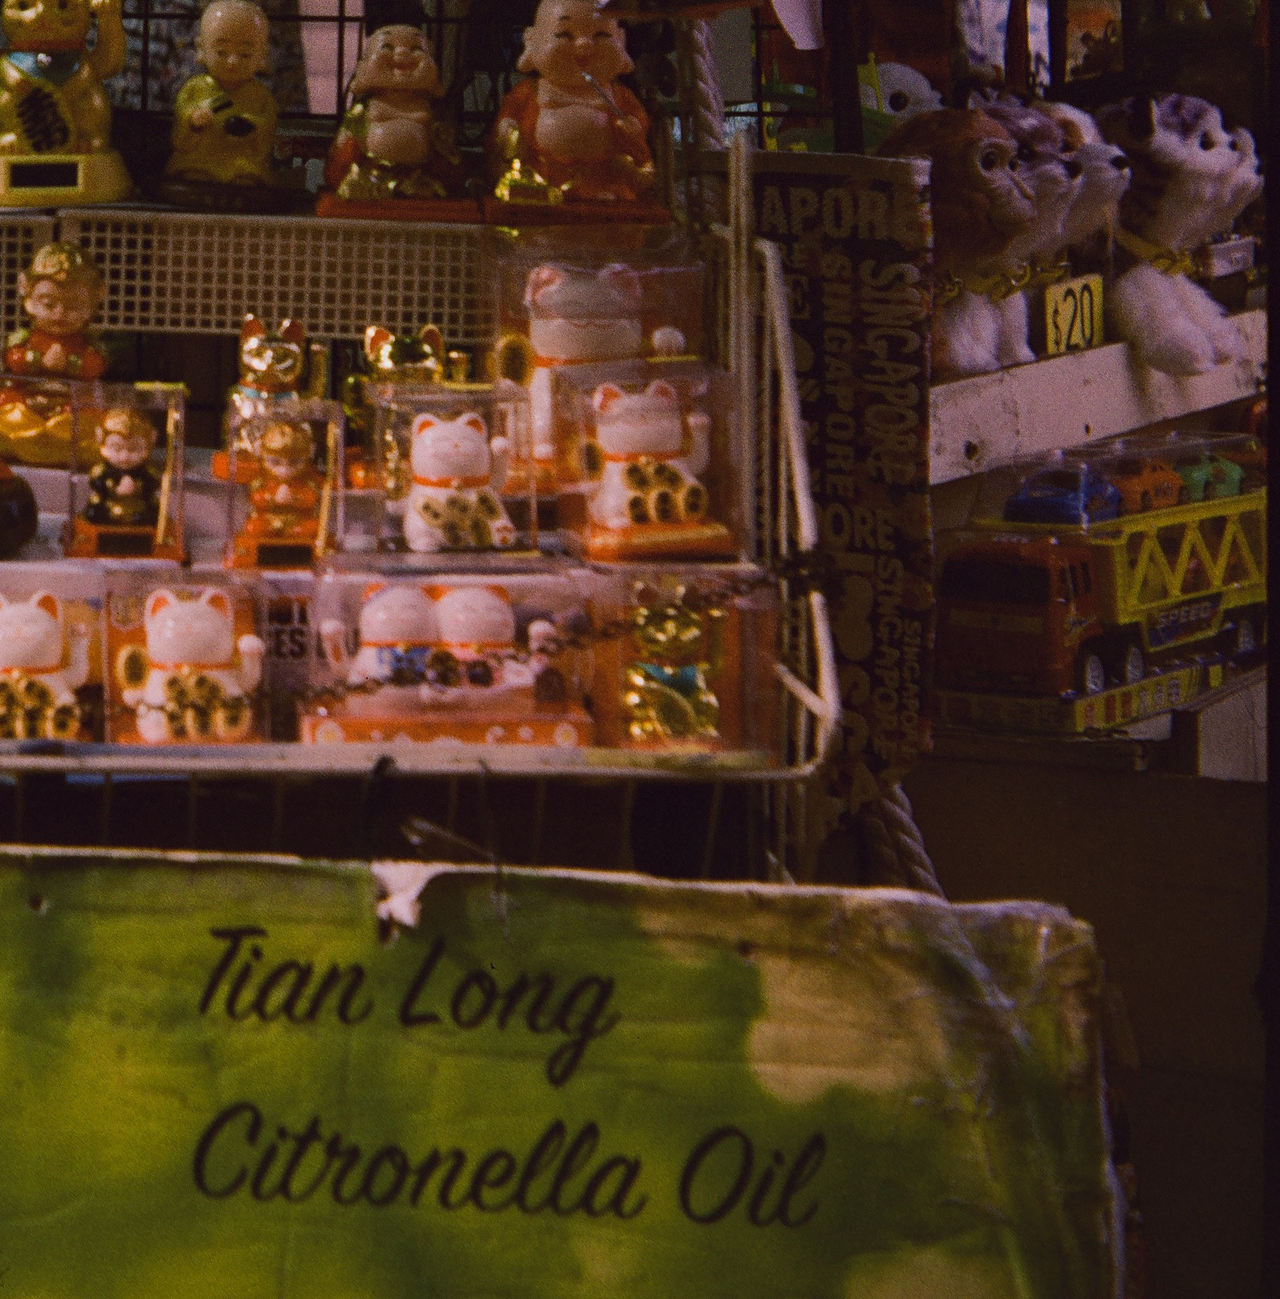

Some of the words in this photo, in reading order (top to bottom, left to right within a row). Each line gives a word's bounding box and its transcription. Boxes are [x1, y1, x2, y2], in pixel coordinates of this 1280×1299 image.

[1051, 283, 1094, 353] $20
[196, 924, 374, 1027] Tian
[396, 936, 623, 1089] Long
[192, 1103, 649, 1221] Citronella
[675, 1126, 828, 1229] Oil
